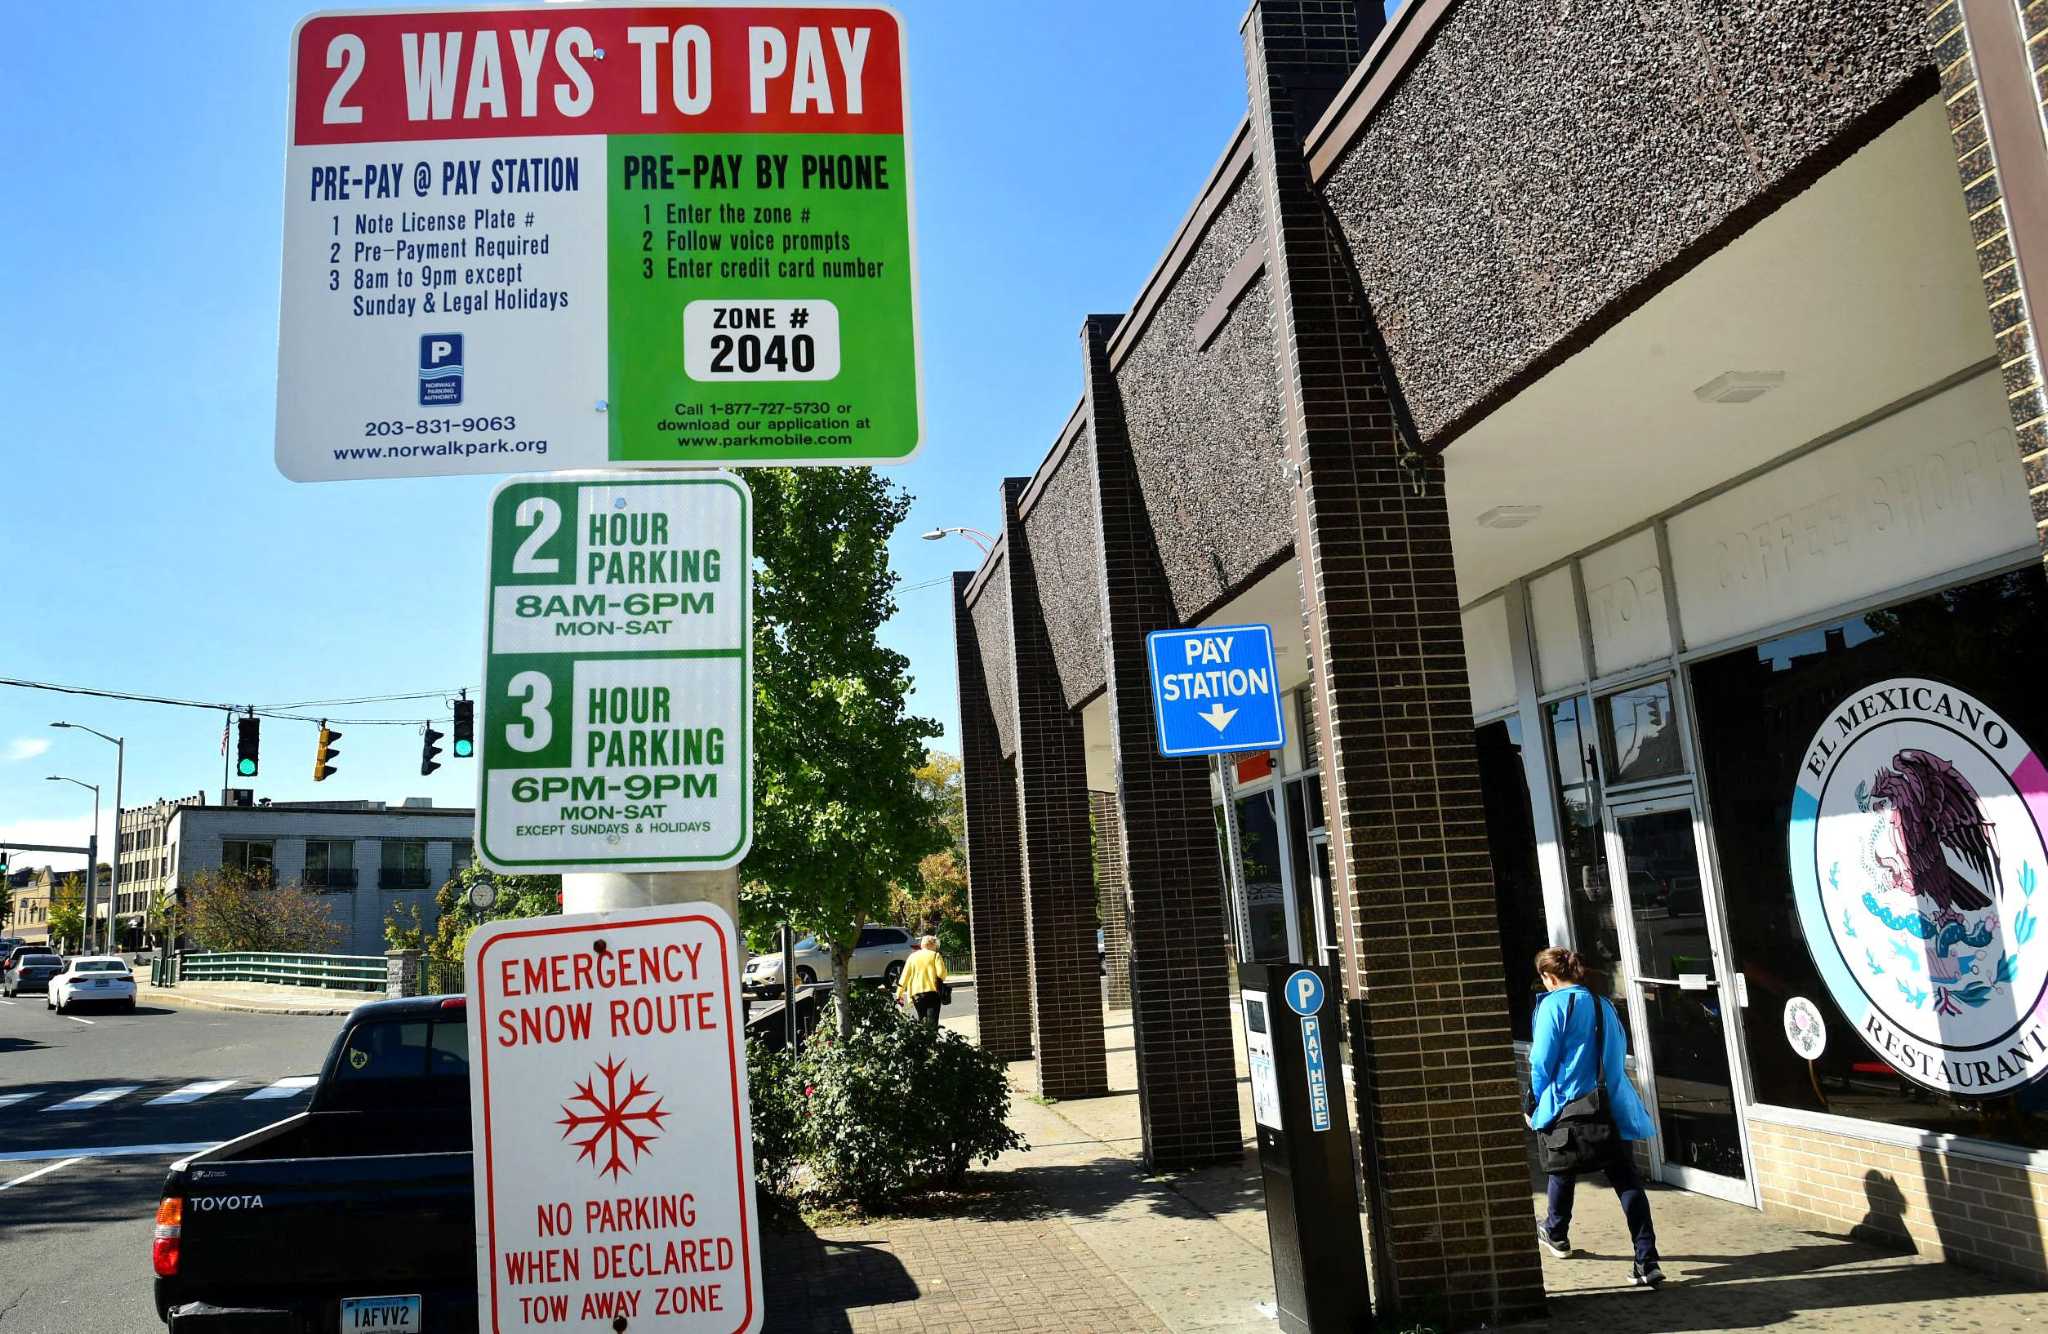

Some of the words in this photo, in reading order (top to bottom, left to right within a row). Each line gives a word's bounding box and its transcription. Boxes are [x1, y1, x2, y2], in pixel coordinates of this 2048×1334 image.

[322, 34, 366, 126] 2
[401, 26, 595, 122] WAYS
[628, 24, 712, 116] TO
[749, 27, 871, 115] PAY
[311, 162, 404, 201] PRE-PAY
[414, 161, 431, 197] @
[442, 160, 481, 195] PAY
[491, 157, 579, 194] STATION
[624, 154, 743, 190] PRE-PAY
[756, 154, 788, 190] BY
[802, 155, 889, 190] PHONE
[332, 215, 340, 236] 1
[355, 213, 394, 235] Note
[402, 211, 466, 232] License
[474, 209, 516, 230] Plate
[524, 211, 536, 227] #
[643, 204, 650, 225] 1
[666, 203, 712, 224] Enter
[719, 203, 746, 224] the
[753, 207, 792, 224] zone
[800, 208, 811, 223] #
[330, 242, 341, 263] 2
[354, 238, 467, 263] Pre-Payment
[475, 234, 550, 261] Required
[642, 230, 653, 251] 2
[667, 230, 722, 251] Follow
[731, 230, 775, 251] voice
[783, 230, 850, 254] prompts
[329, 270, 340, 291] 3
[354, 268, 389, 290] 8am
[397, 267, 413, 288] to
[422, 265, 457, 294] 9pm
[465, 263, 523, 291] except
[643, 258, 653, 279] 3
[667, 257, 712, 279] Enter
[720, 257, 770, 278] credit
[778, 257, 815, 278] card
[823, 257, 885, 278] number
[353, 294, 416, 318] Sunday
[423, 292, 435, 314] &
[443, 290, 488, 315] Legal
[495, 288, 569, 311] Holidays
[713, 307, 776, 329] ZONE
[789, 307, 809, 329] #
[431, 341, 452, 363] P
[710, 334, 815, 373] 2040
[675, 403, 703, 416] Call
[710, 402, 830, 416] 1-877-727-5730
[836, 404, 852, 415] or
[365, 416, 516, 437] 203-831-9063
[657, 418, 730, 431] download
[736, 420, 761, 431] our
[767, 417, 849, 433] application
[856, 417, 871, 430] at
[334, 438, 547, 461] www.norwalkpark.org
[677, 434, 852, 449] www.parkmobile.com
[512, 496, 562, 575] 2
[589, 512, 669, 546] HOUR
[588, 549, 721, 585] PARKING
[515, 591, 714, 618] 8AM-6PM
[555, 620, 673, 636] MON-SAT
[1184, 636, 1234, 666] PAY
[1163, 667, 1269, 701] STATION
[505, 670, 553, 753] 3
[588, 686, 670, 724] HOUR
[587, 727, 724, 768] PARKING
[1806, 736, 1837, 780] EL
[1834, 687, 2008, 750] MEXICANO
[511, 773, 718, 803] 6PM-9PM
[560, 804, 668, 821] MON-SAT
[516, 824, 565, 837] EXCEPT
[571, 823, 629, 835] SUNDAYS
[635, 823, 643, 834] &
[650, 821, 711, 834] HOLIDAYS
[501, 942, 702, 997] EMERGENCY
[1297, 978, 1315, 1009] P
[498, 1002, 592, 1047] SNOW
[609, 992, 717, 1038] ROUTE
[1305, 1021, 1319, 1064] PAY
[1865, 1013, 2048, 1088] RESTAURANT
[1310, 1068, 1328, 1126] HERE
[190, 1195, 264, 1212] TOYOTA
[537, 1202, 572, 1238] NO
[586, 1193, 696, 1234] PARKING
[505, 1248, 580, 1286] WHEN
[593, 1237, 734, 1280] DECLARED
[519, 1295, 569, 1324] TOW
[580, 1290, 642, 1321] AWAY
[655, 1284, 723, 1316] ZONE
